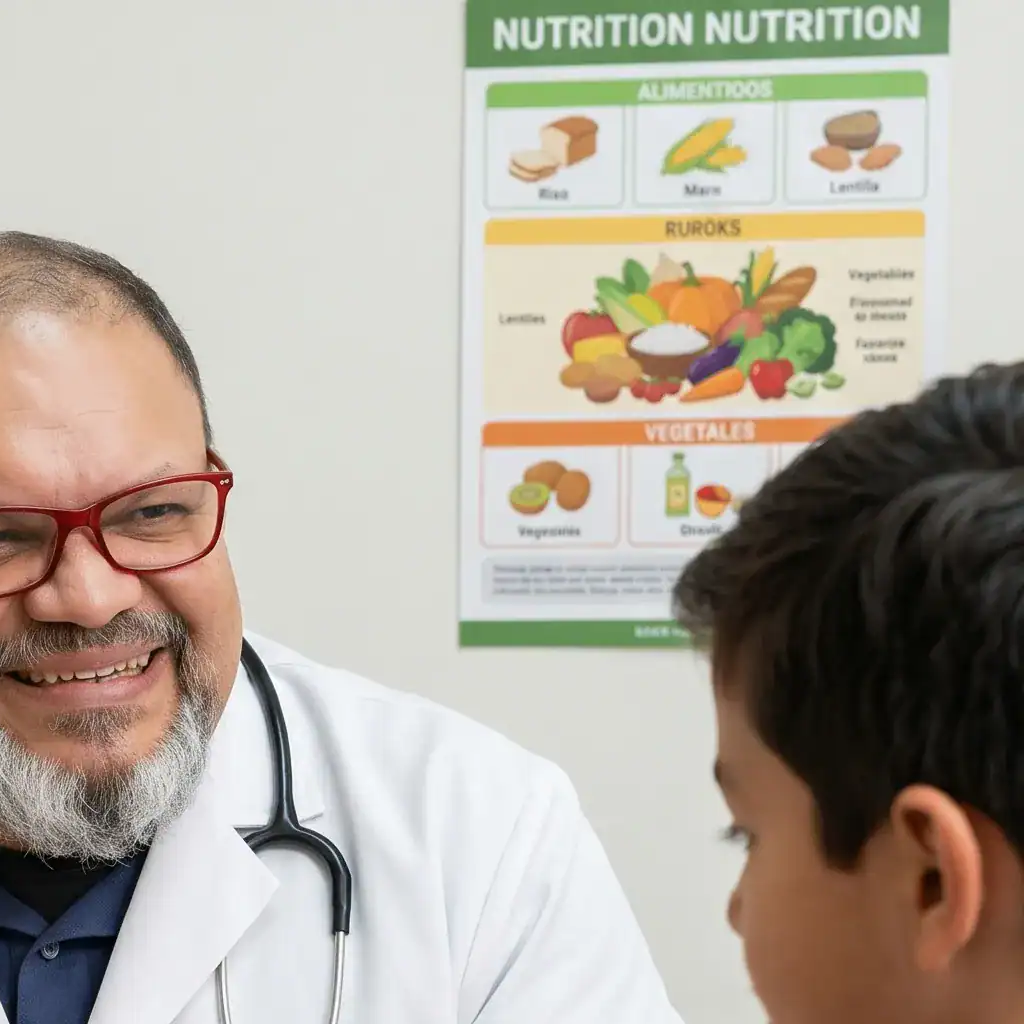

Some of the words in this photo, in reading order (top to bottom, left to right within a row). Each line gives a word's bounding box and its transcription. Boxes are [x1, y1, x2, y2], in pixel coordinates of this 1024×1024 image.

[492, 12, 694, 51] NUTRITION
[704, 5, 921, 45] NUTRITION
[643, 420, 756, 442] VEGETALES
